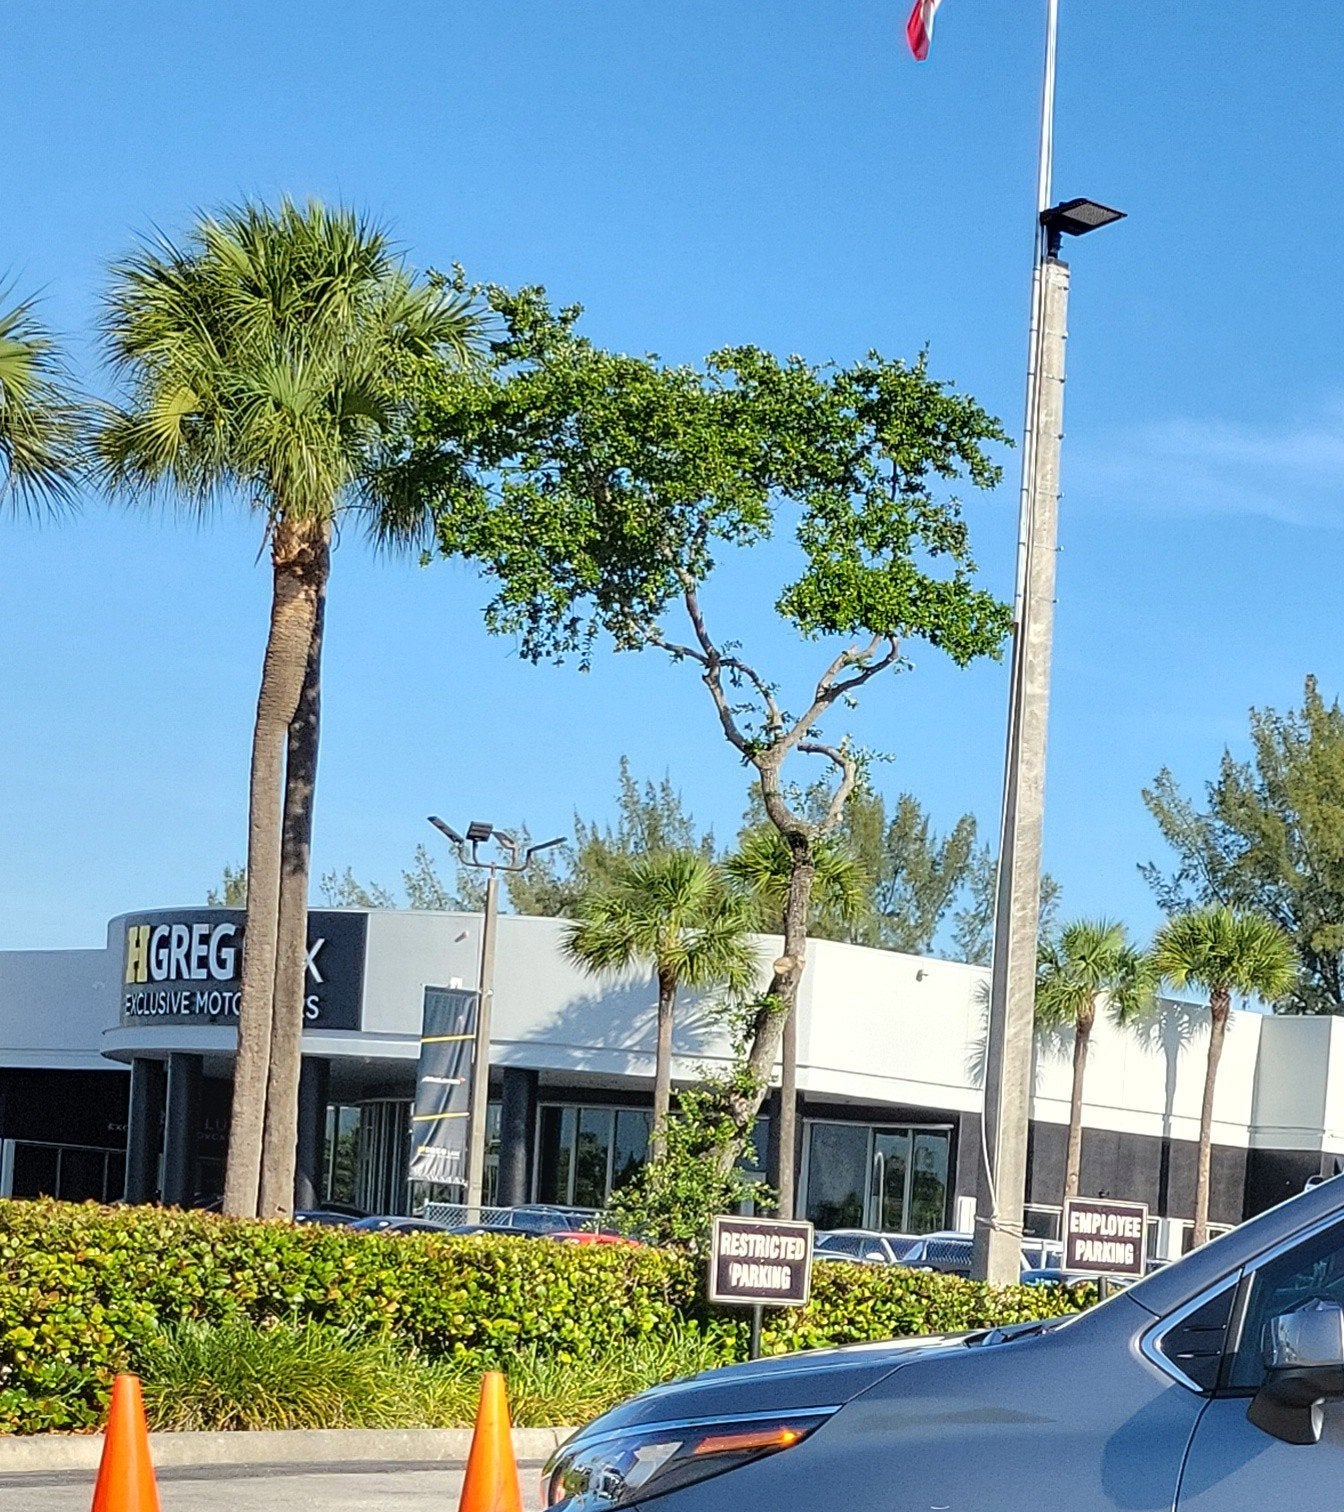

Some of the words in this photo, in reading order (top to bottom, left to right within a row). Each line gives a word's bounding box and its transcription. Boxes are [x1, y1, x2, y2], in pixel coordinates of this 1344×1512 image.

[125, 991, 191, 1015] EXCLUSIVE
[1070, 1210, 1142, 1238] EMPLOYEE
[720, 1231, 806, 1261] RESTRICTED
[1075, 1239, 1134, 1265] PARKING
[730, 1262, 792, 1290] PARKING
